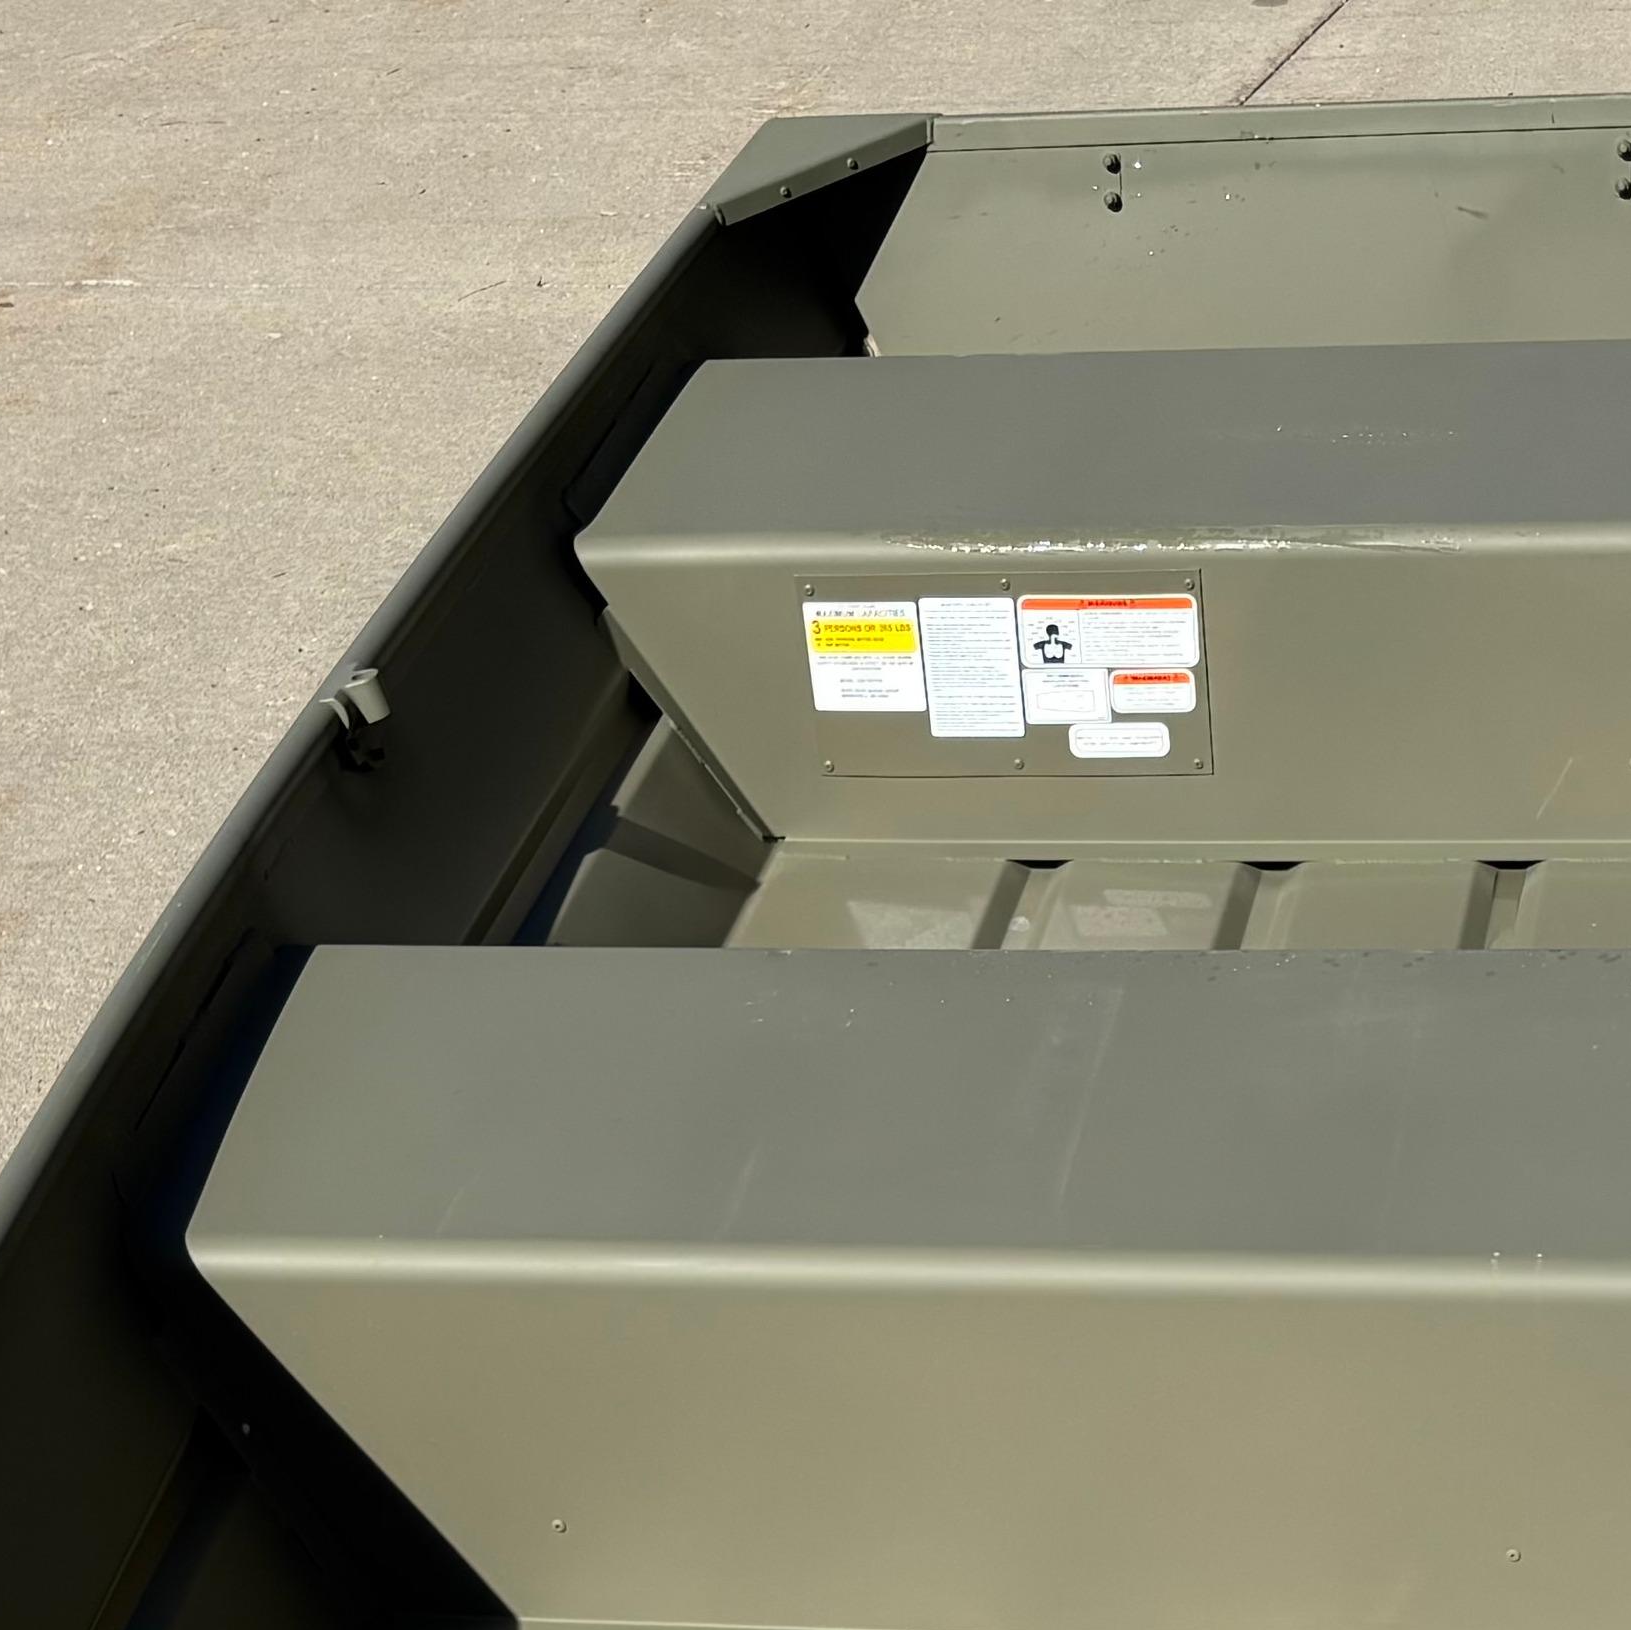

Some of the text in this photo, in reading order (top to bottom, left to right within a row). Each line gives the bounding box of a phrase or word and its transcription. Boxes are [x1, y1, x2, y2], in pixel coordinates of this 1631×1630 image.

[857, 609, 905, 618] APACITIES
[812, 620, 821, 634] 3
[824, 624, 862, 633] PERSONS
[864, 624, 876, 633] OR
